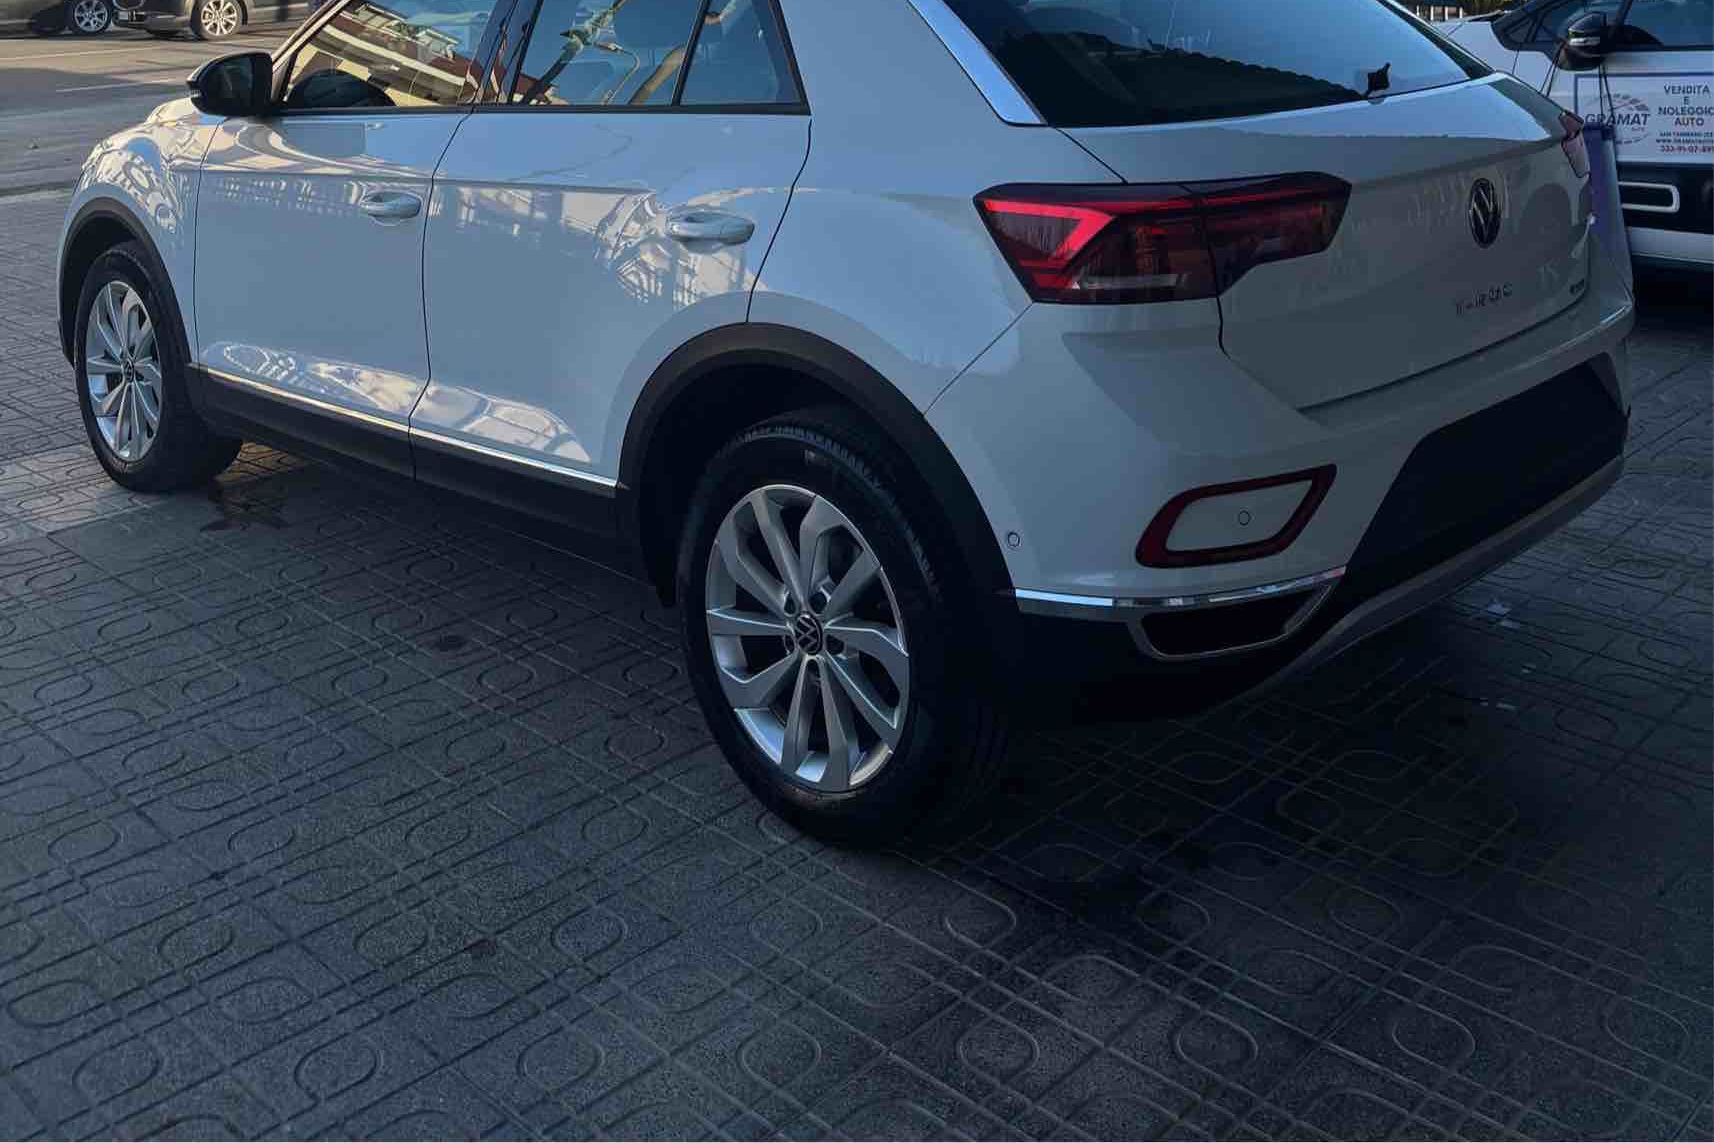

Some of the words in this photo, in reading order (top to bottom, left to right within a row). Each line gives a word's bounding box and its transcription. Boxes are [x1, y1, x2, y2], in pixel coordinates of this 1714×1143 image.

[1663, 84, 1710, 95] VENDITA
[1586, 113, 1650, 126] GRAMAT
[1675, 117, 1705, 126] AUTO
